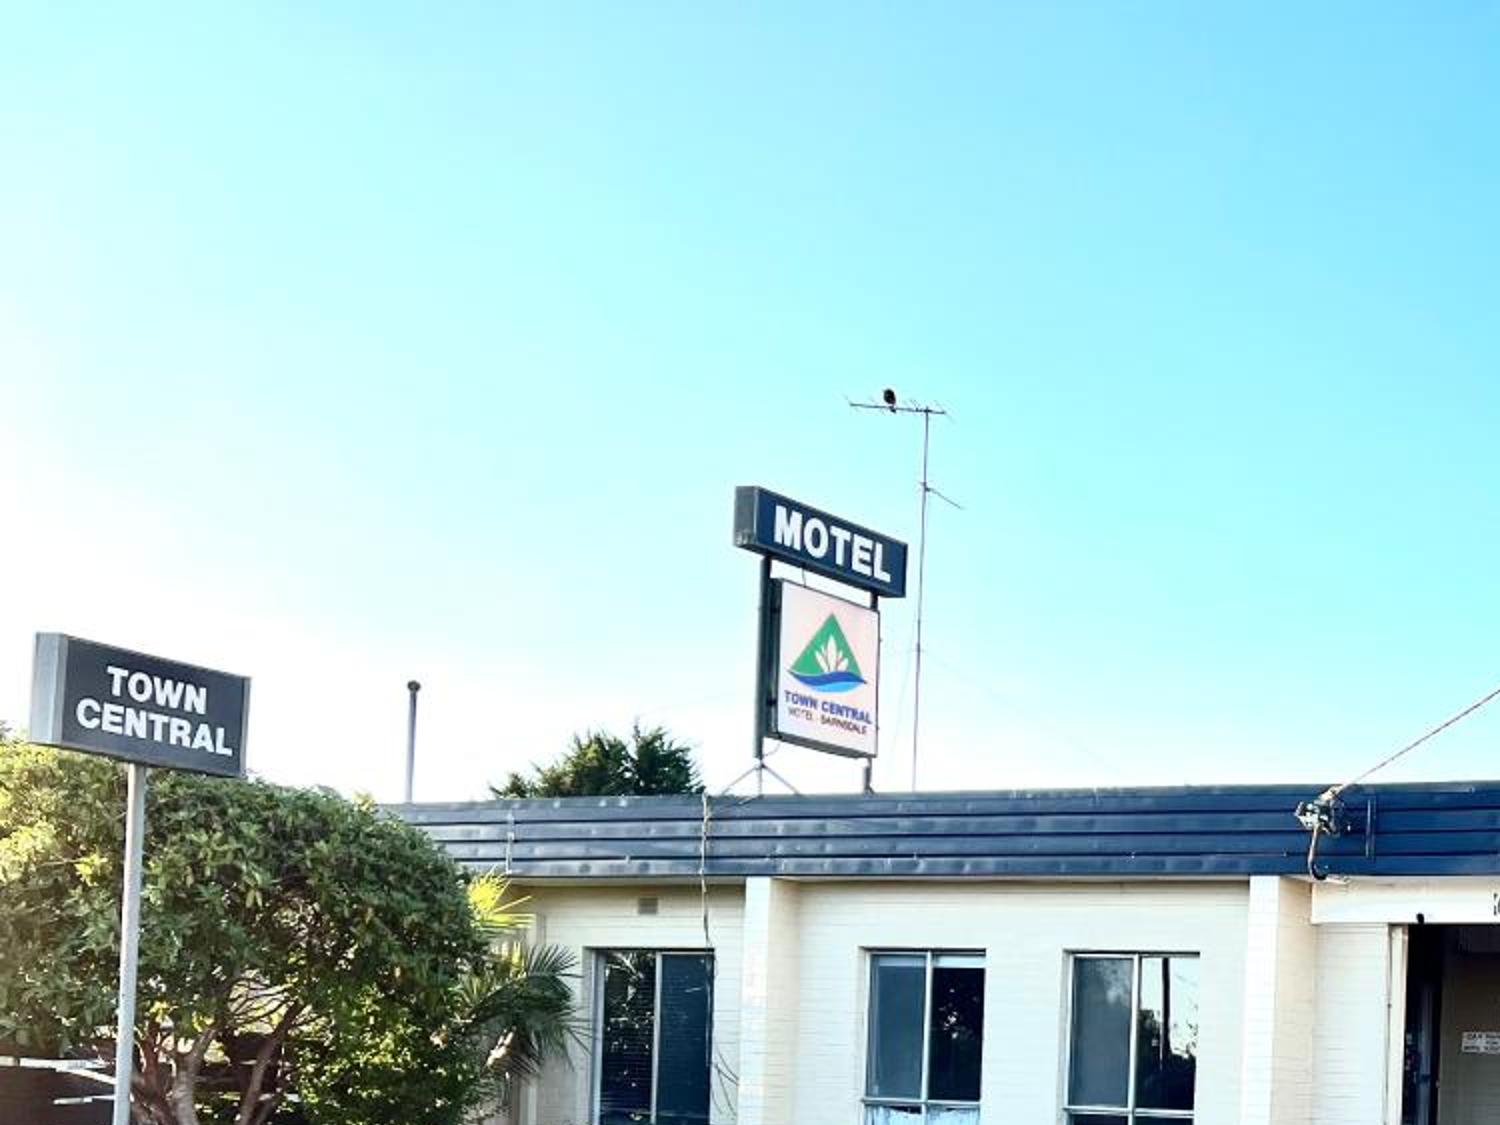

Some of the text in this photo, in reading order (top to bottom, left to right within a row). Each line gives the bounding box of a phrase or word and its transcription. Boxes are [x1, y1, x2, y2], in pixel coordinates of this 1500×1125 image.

[774, 505, 891, 583] MOTEL
[107, 666, 207, 715] TOWN
[784, 690, 872, 724] TOWN CENTRAL
[76, 698, 233, 757] CENTRAL
